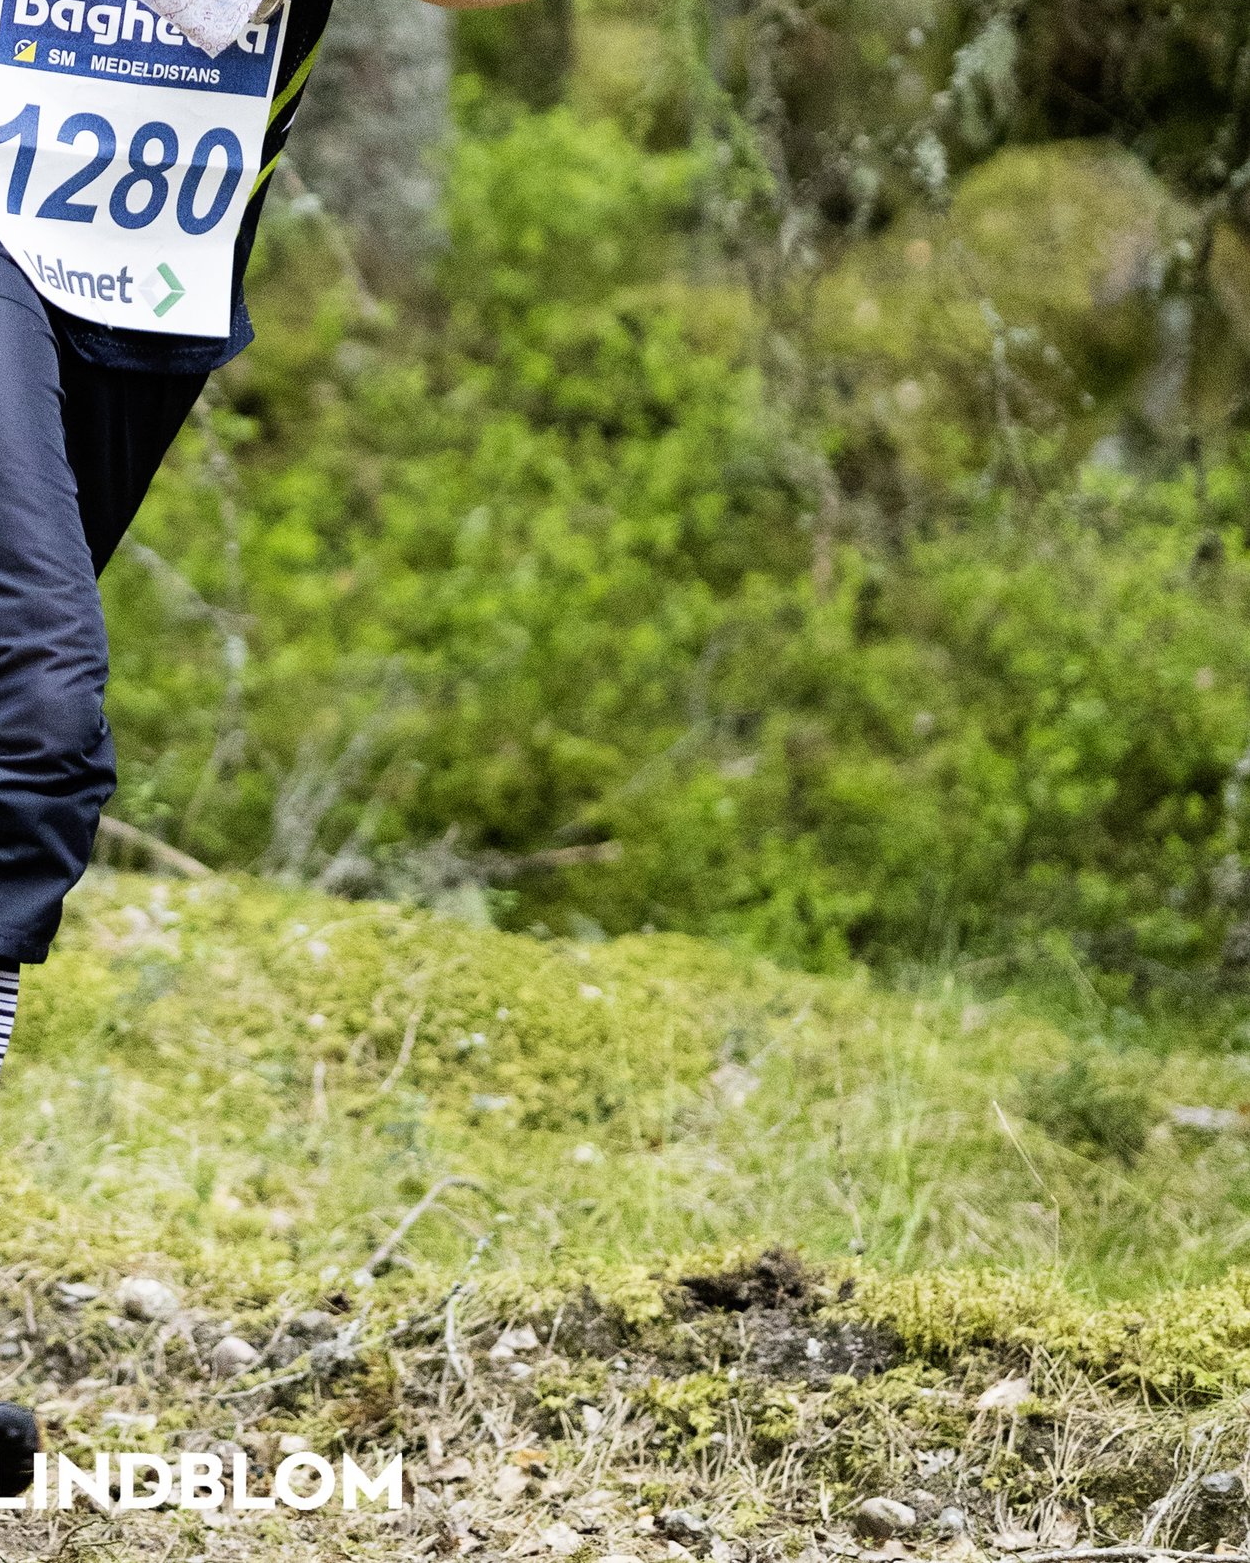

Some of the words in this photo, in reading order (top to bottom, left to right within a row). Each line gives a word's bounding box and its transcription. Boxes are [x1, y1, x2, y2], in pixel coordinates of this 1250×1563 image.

[48, 48, 76, 68] SM
[90, 55, 221, 85] MEDELDISTANS
[23, 250, 134, 305] Valmet
